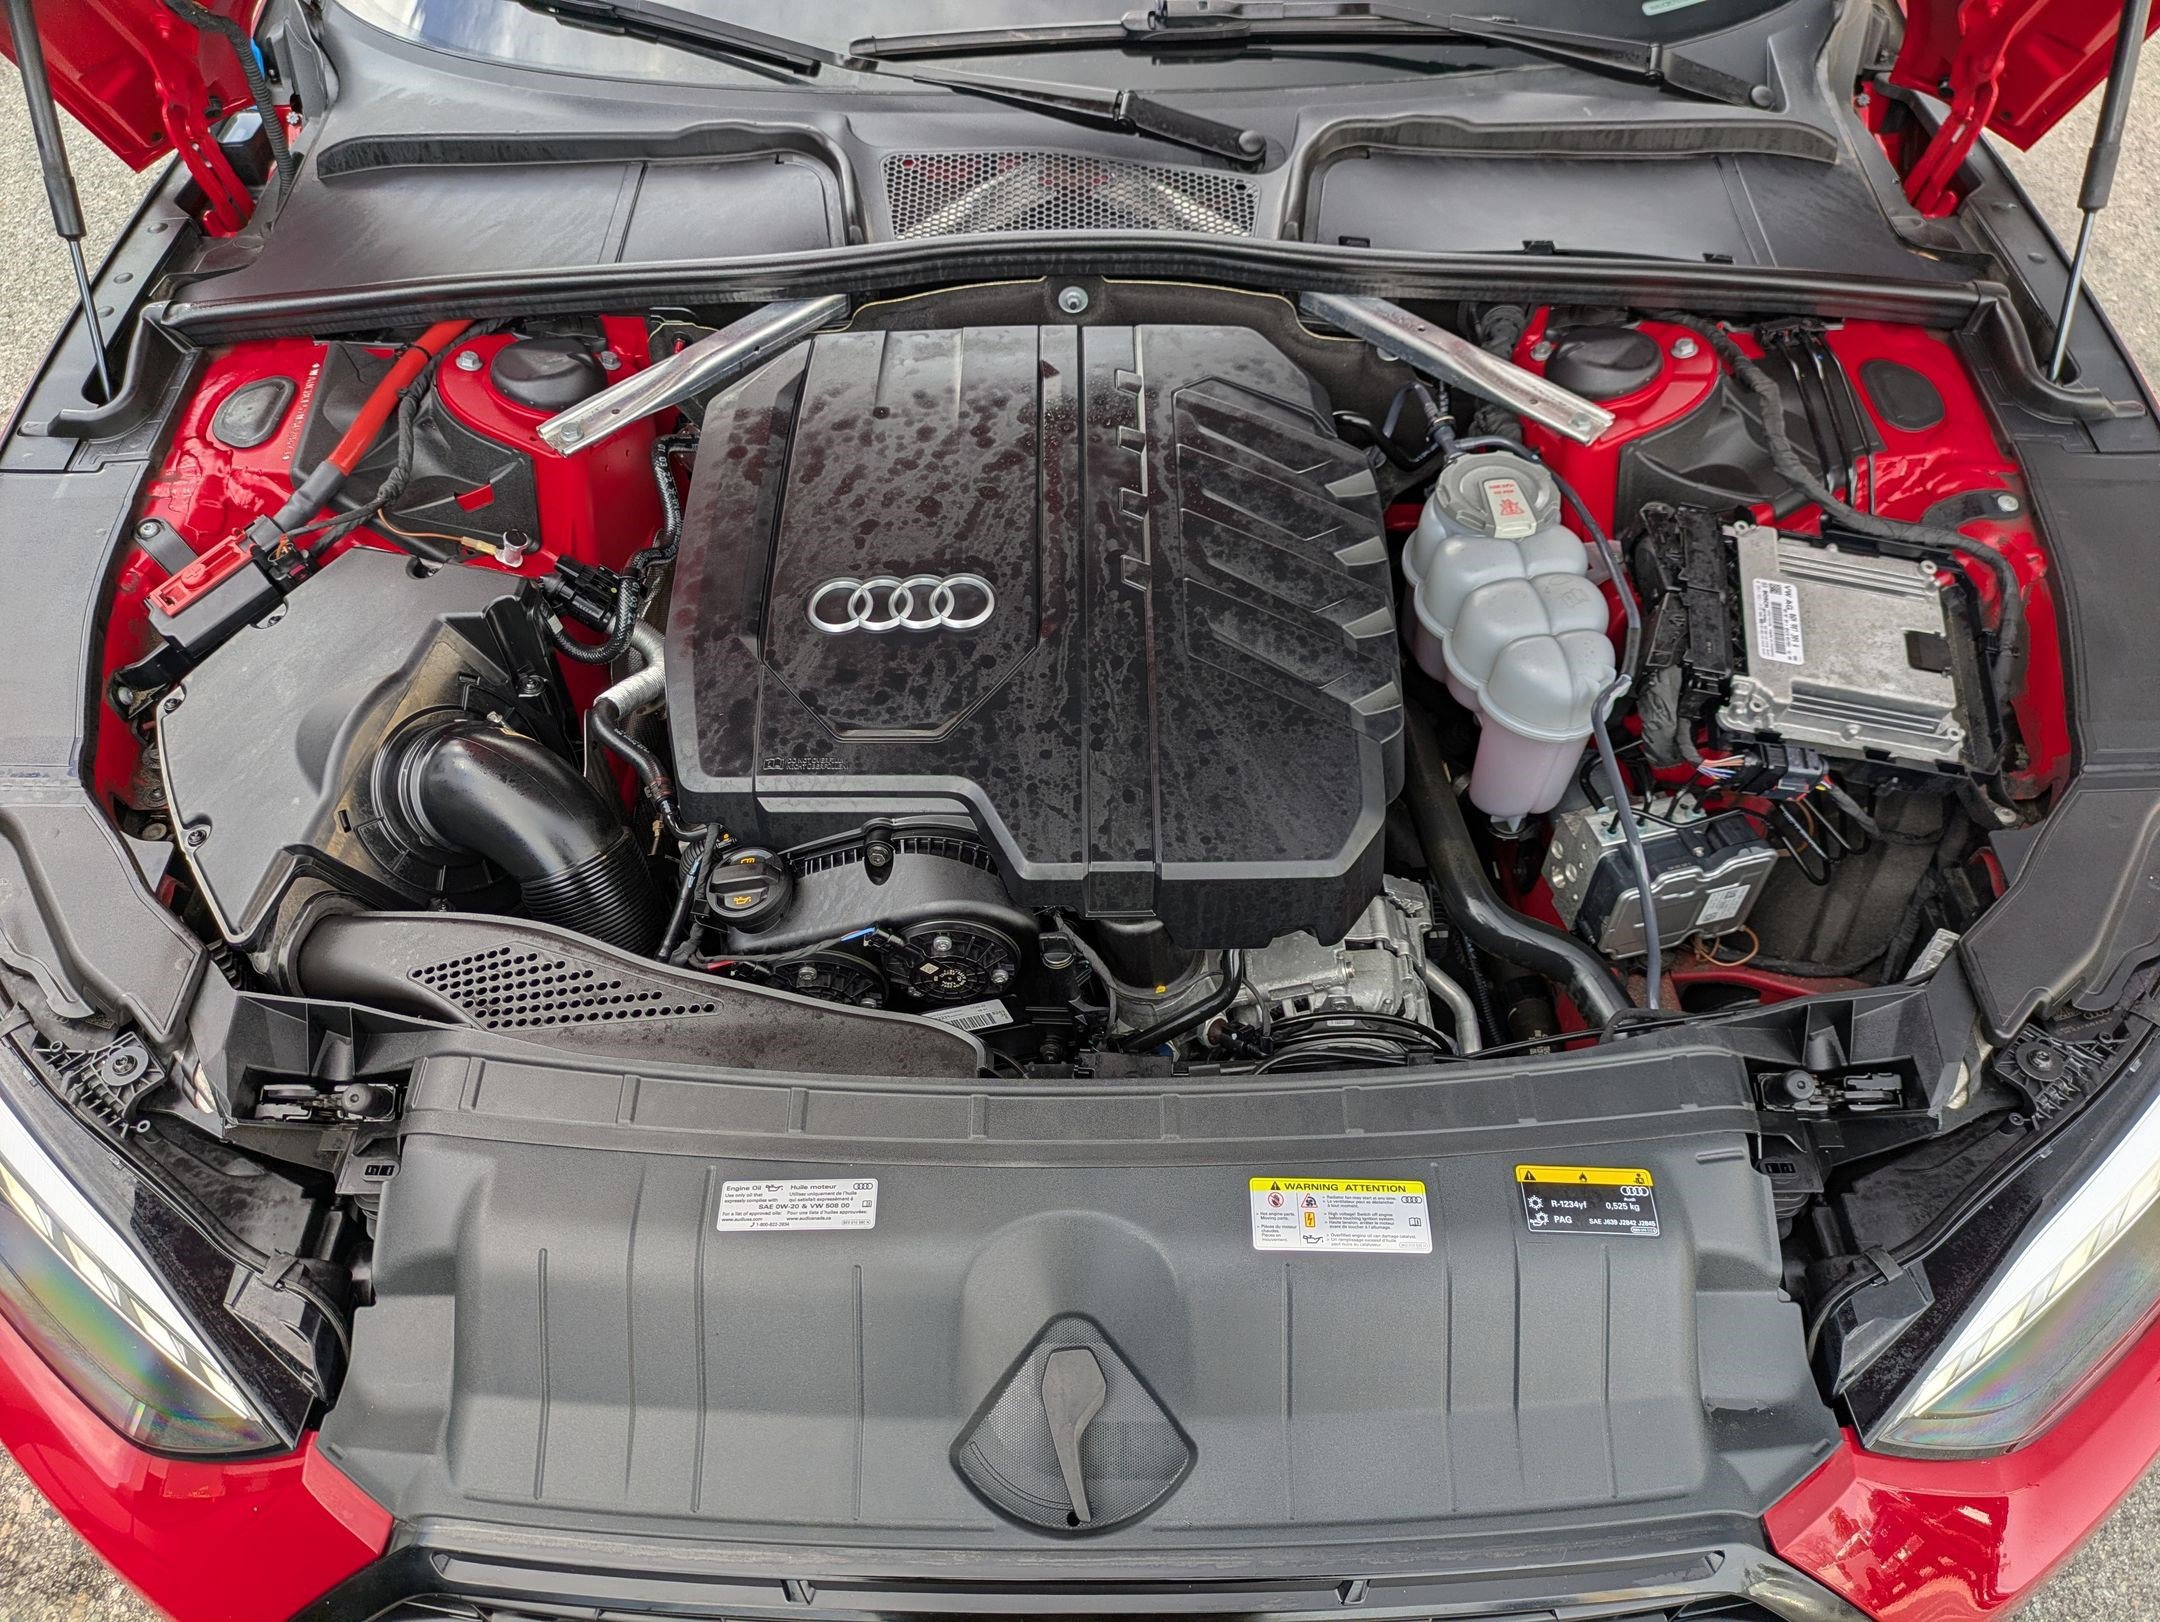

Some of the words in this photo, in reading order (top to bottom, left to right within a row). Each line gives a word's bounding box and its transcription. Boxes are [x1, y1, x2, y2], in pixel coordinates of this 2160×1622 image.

[1784, 586, 1792, 598] VW
[1786, 599, 1793, 610] AG
[1284, 1183, 1339, 1191] WARNING
[1345, 1183, 1406, 1192] ATTENTION
[1551, 1200, 1587, 1210] R-1234yf
[1606, 1202, 1628, 1210] 0,525
[1630, 1202, 1640, 1212] kg
